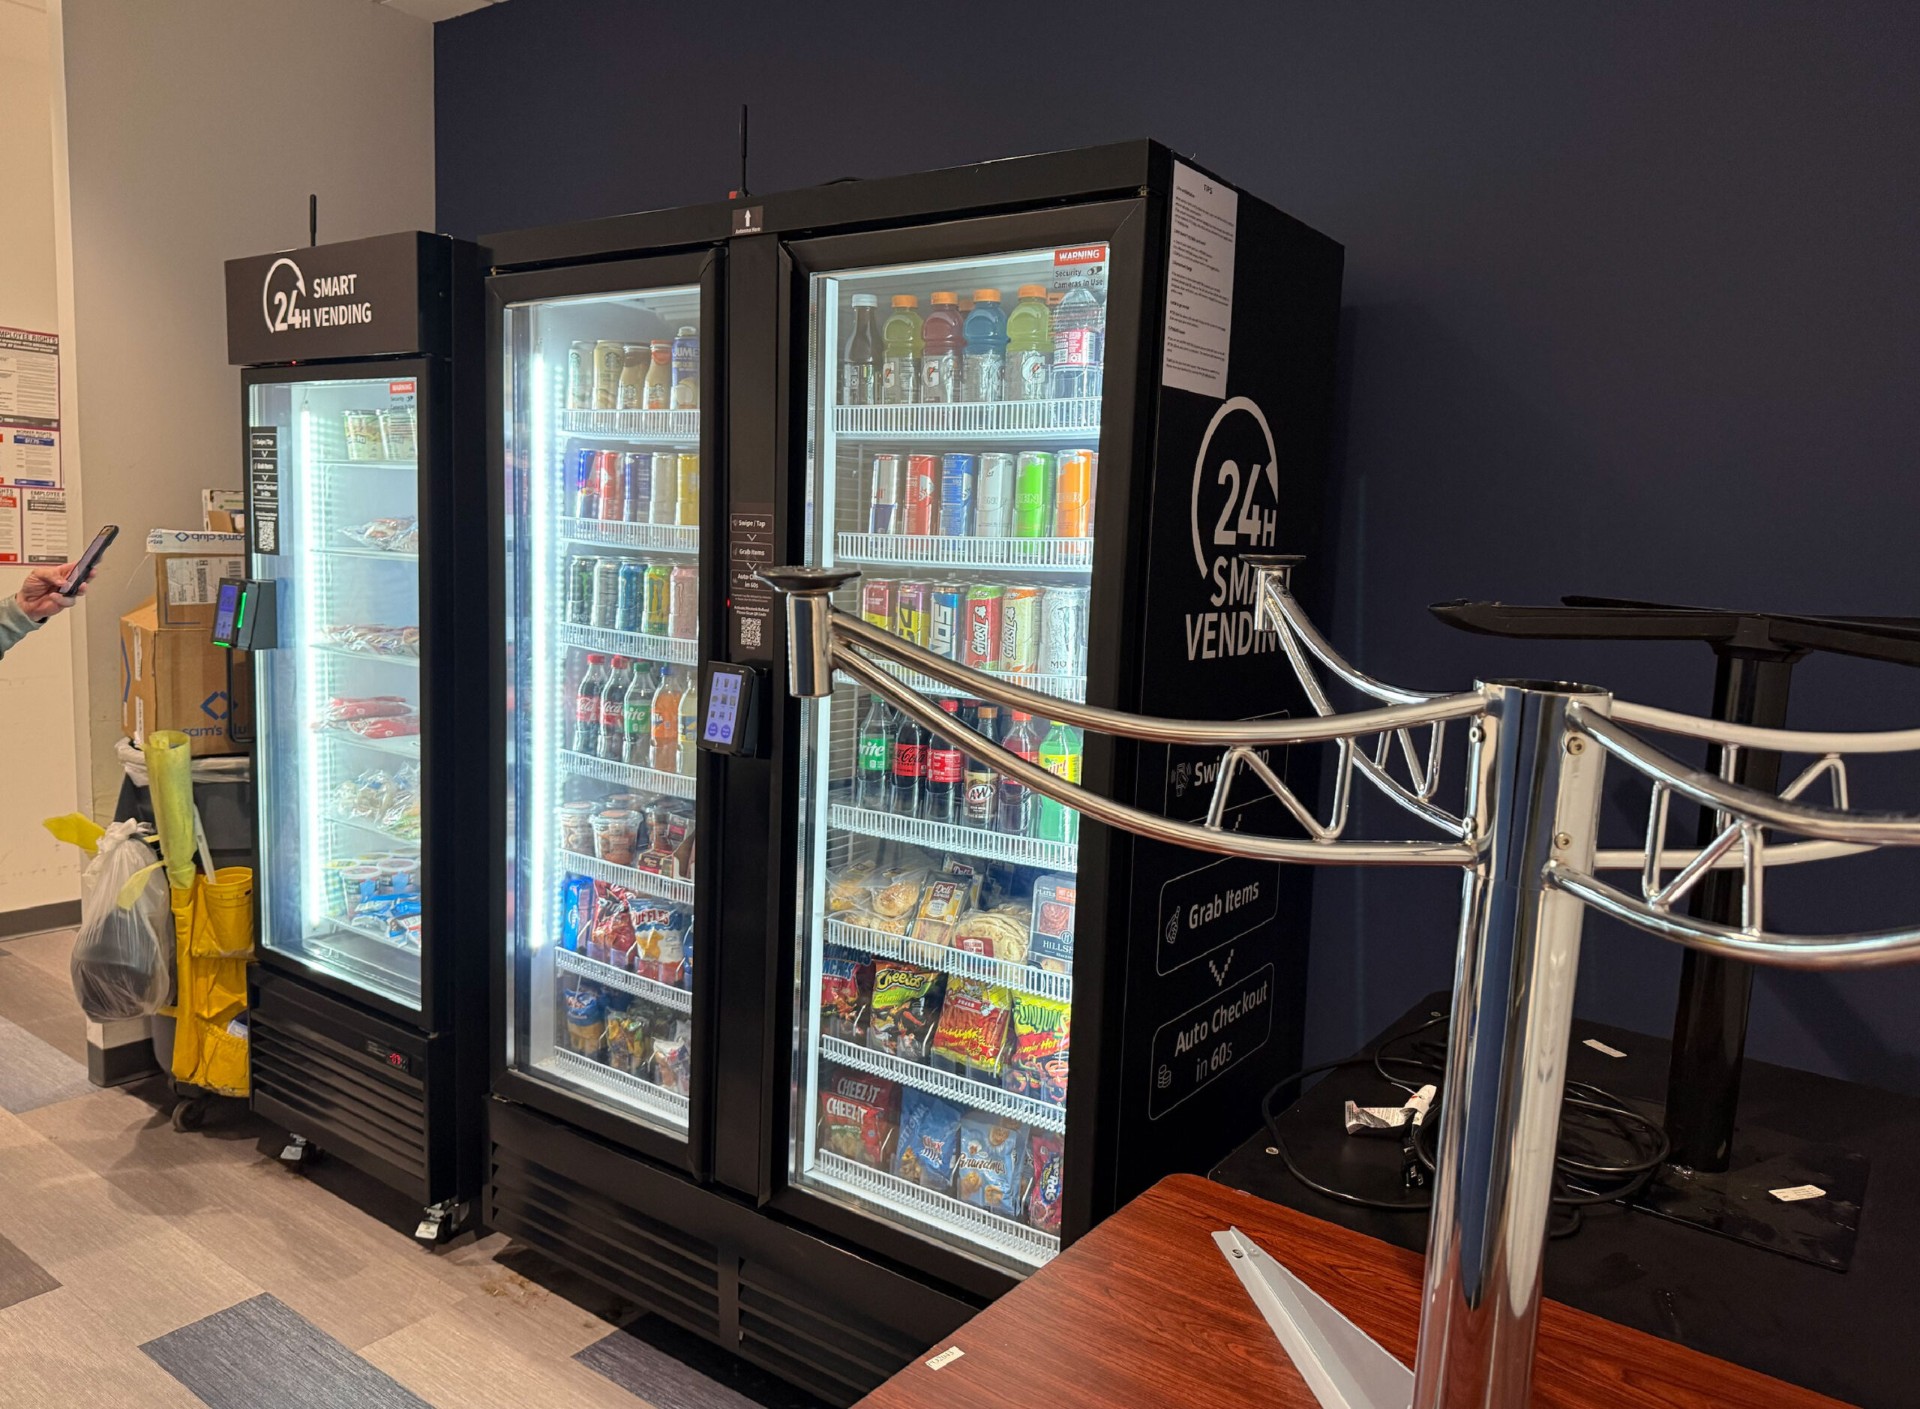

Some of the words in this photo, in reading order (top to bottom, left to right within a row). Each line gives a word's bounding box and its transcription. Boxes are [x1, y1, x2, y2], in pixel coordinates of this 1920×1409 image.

[1203, 183, 1213, 195] TIPS
[1059, 249, 1100, 261] WARNING
[1053, 280, 1082, 289] Cameras
[1091, 278, 1103, 286] Use
[1055, 269, 1082, 278] Security
[313, 274, 357, 299] SMART
[313, 302, 372, 328] VENDING
[31, 335, 57, 345] RIGHTS
[673, 345, 699, 358] JUME
[1185, 610, 1286, 661] VENDIN
[1194, 755, 1228, 787] Swi
[1188, 894, 1222, 930] Grab
[1225, 881, 1260, 914] Items
[634, 909, 669, 926] UFFLES
[877, 969, 922, 990] Cheetos
[1174, 1020, 1209, 1058] Auto
[1211, 980, 1269, 1034] Checkout
[1195, 1057, 1207, 1083] in
[1210, 1042, 1233, 1072] 60s
